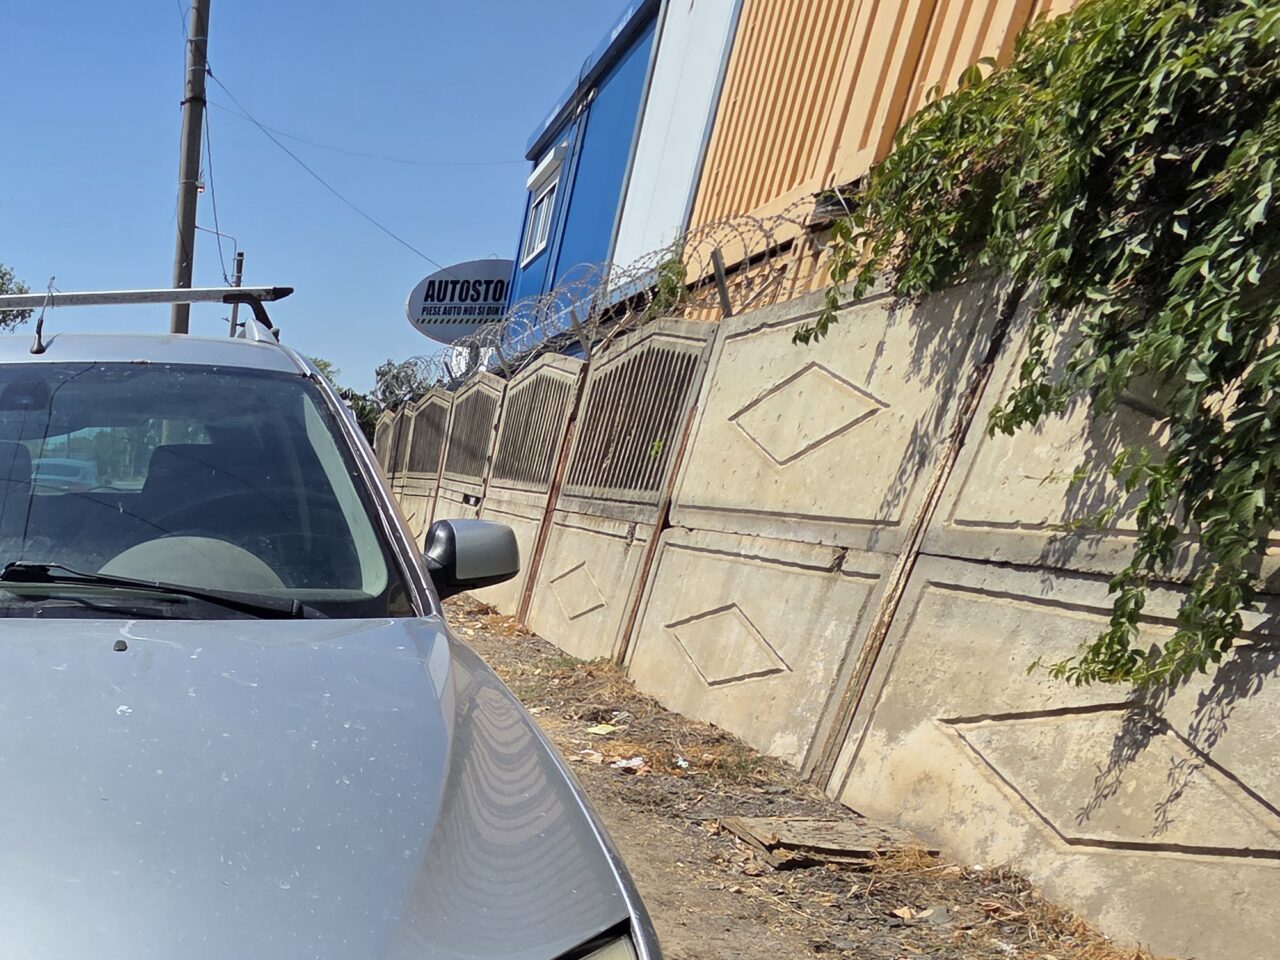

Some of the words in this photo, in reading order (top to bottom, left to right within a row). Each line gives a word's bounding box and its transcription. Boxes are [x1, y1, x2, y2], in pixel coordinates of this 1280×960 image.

[421, 306, 442, 316] PIESE
[442, 306, 462, 316] AUTO
[463, 306, 476, 316] NOI
[477, 306, 486, 316] SI
[486, 306, 500, 316] DIN
